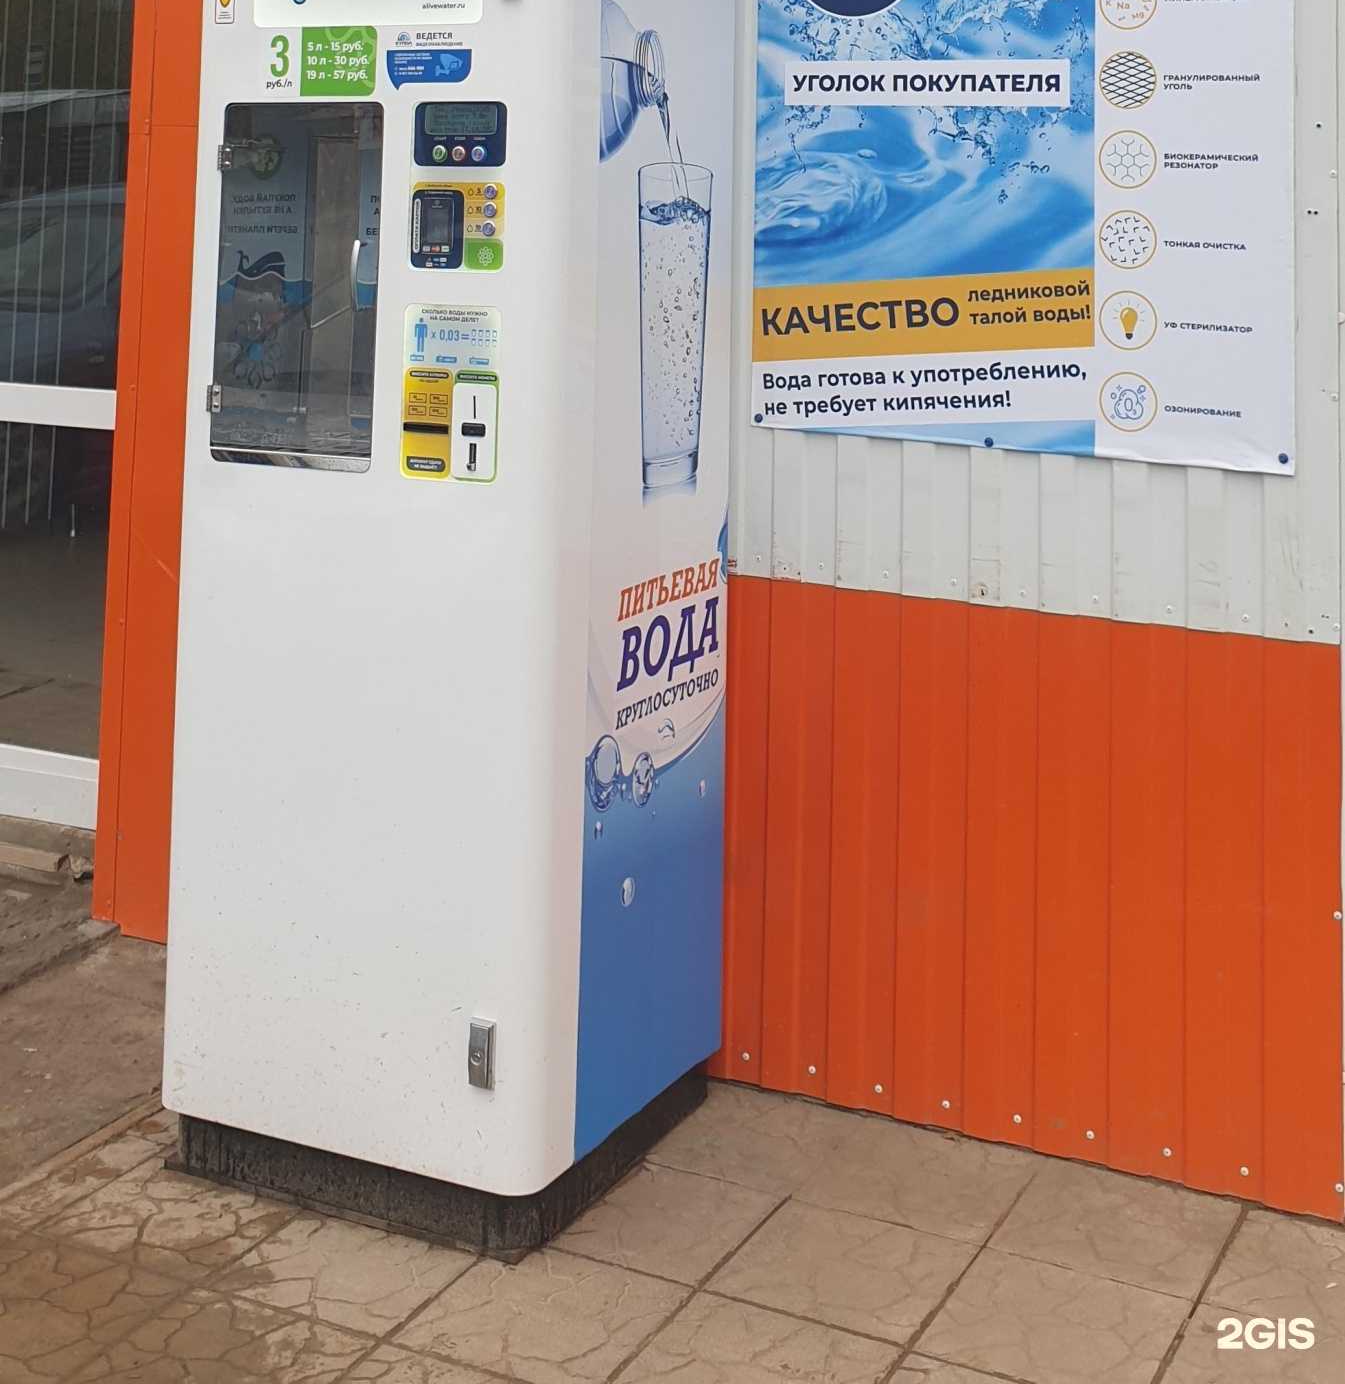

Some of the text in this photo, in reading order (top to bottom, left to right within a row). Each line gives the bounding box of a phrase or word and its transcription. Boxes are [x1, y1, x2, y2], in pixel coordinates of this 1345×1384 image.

[416, 32, 453, 40] ВЕДЕТСЯ
[307, 42, 314, 51] 5
[315, 43, 323, 51] л
[271, 35, 289, 78] 3
[307, 56, 317, 65] 10
[319, 57, 326, 65] л
[333, 56, 347, 65] 30
[348, 55, 370, 66] руб.
[306, 71, 317, 80] 19
[333, 71, 345, 80] 57
[347, 70, 368, 81] руб.
[1163, 74, 1260, 82] ГРАНУЛИРОВАННЫЙ
[266, 79, 293, 89] руб./л
[793, 74, 1061, 93] УГОЛОК ПОКУПАТЕЛЯ
[1164, 152, 1259, 162] БИОКЕРАМИЧЕСКИЙ
[1164, 162, 1219, 170] РЕЗОНАТОР
[1164, 240, 1246, 250] ТОНКАЯ ОЧИСТКА
[968, 280, 1090, 302] ледниковой
[761, 297, 960, 336] КАЧЕСТВО
[969, 304, 1092, 325] талой воды!
[1164, 321, 1253, 334] УФ СТЕРИЛИЗАТОР
[440, 329, 460, 342] 0,03
[762, 362, 1087, 392] Вода готова к употреблению,
[764, 390, 1012, 418] не требует кипячения!
[1164, 405, 1242, 418] ОЗОНИРОВАНИЕ
[617, 558, 720, 622] ПИТЬЕВАЯ
[616, 596, 719, 692] ВОДА
[616, 668, 719, 730] КРУГЛОСУТОЧНО
